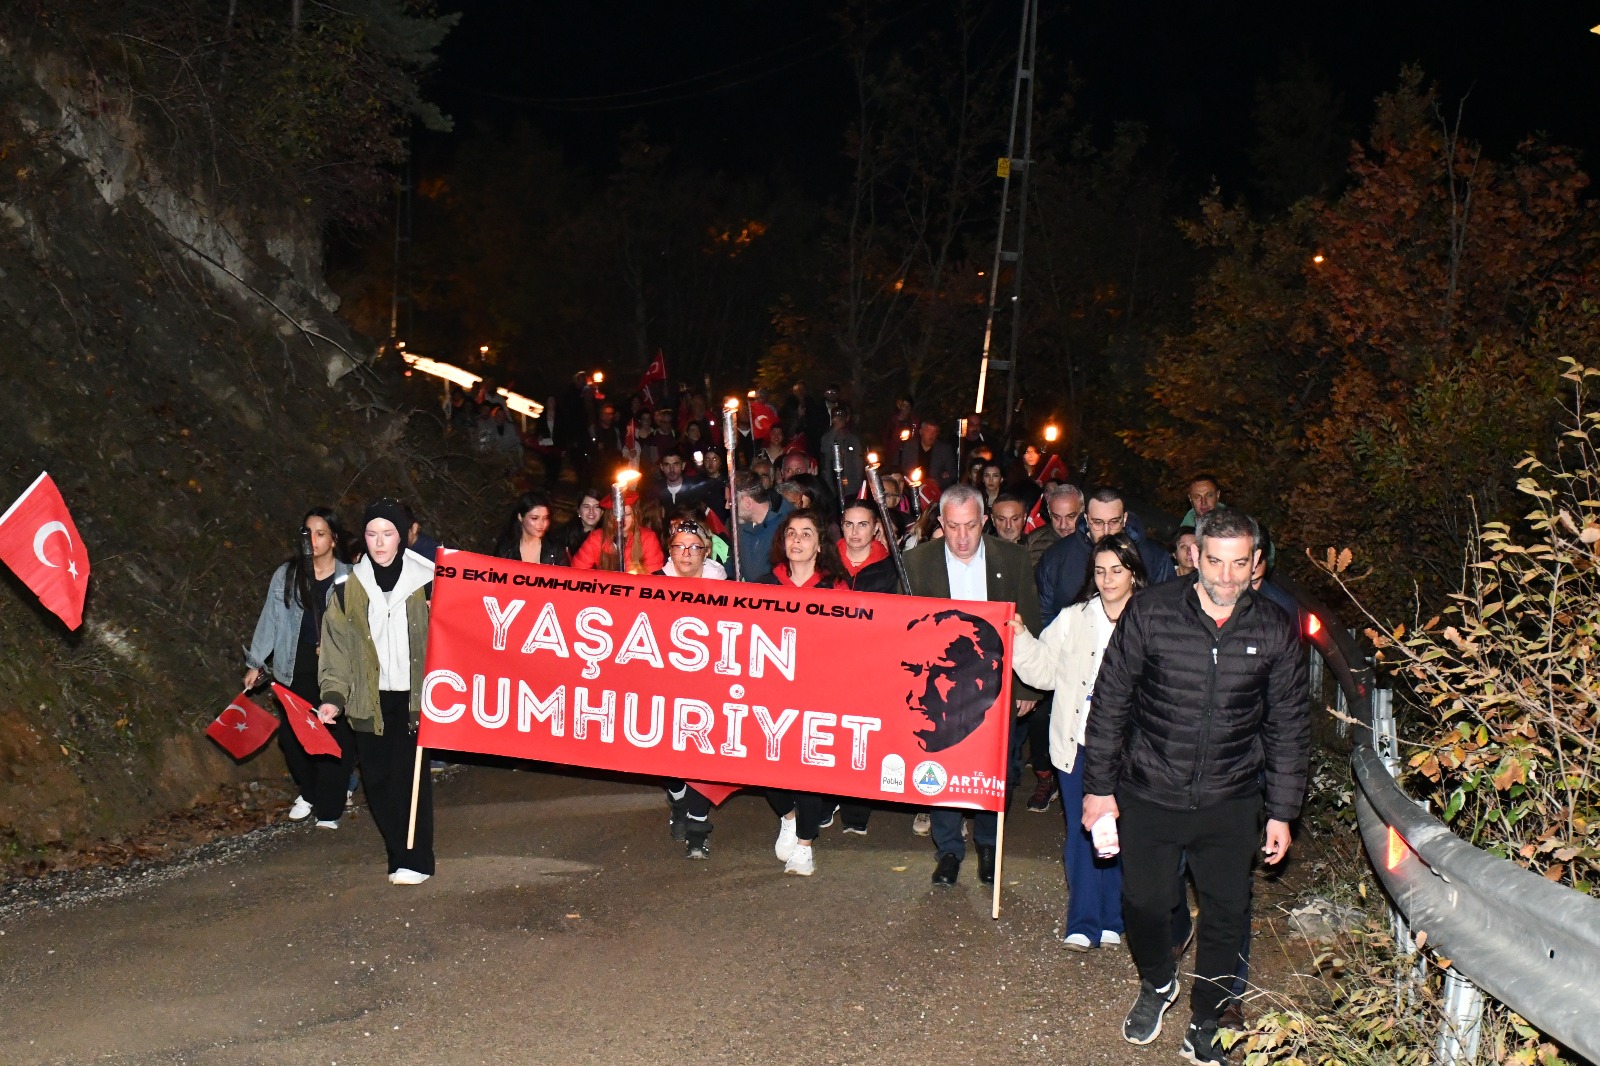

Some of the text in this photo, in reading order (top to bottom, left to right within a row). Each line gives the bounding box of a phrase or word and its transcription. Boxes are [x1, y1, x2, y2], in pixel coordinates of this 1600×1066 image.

[435, 565, 874, 621] 29 EKİM CUMHURİYET BAYRAMI KUTLU OLSUN
[482, 596, 797, 681] YAŞASIN
[421, 669, 882, 771] CUMHURİYET
[949, 775, 1005, 791] ARTVİN
[949, 786, 1005, 798] BELEDİYESİ
